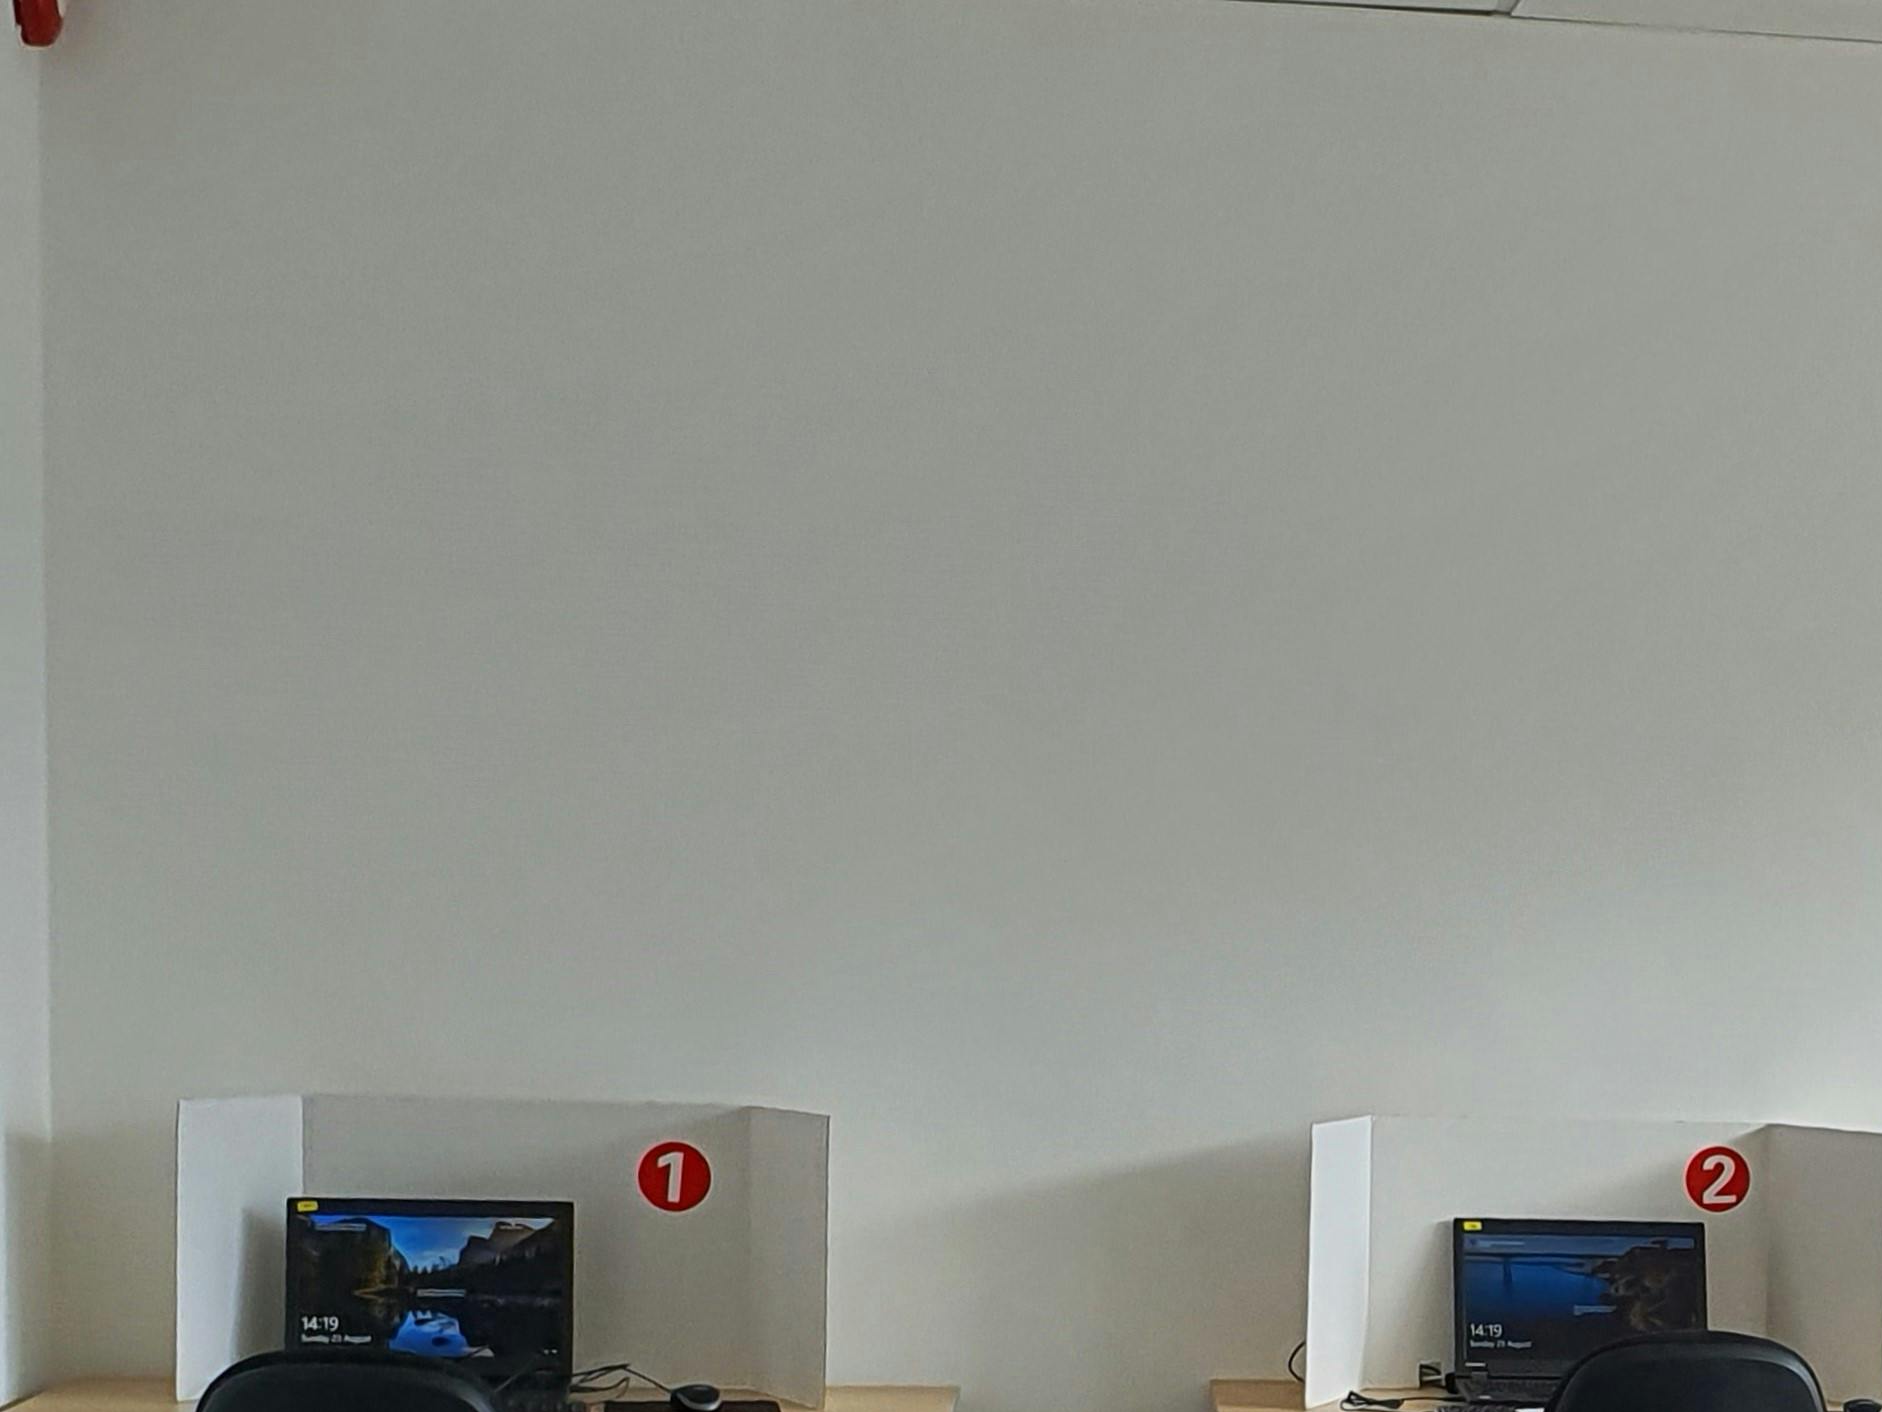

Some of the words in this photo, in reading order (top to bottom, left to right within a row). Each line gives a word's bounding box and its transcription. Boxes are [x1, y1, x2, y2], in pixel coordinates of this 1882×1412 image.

[657, 1152, 685, 1203] 1
[1702, 1155, 1737, 1204] 2
[302, 1316, 339, 1331] 14:19
[1470, 1323, 1502, 1338] 14:19
